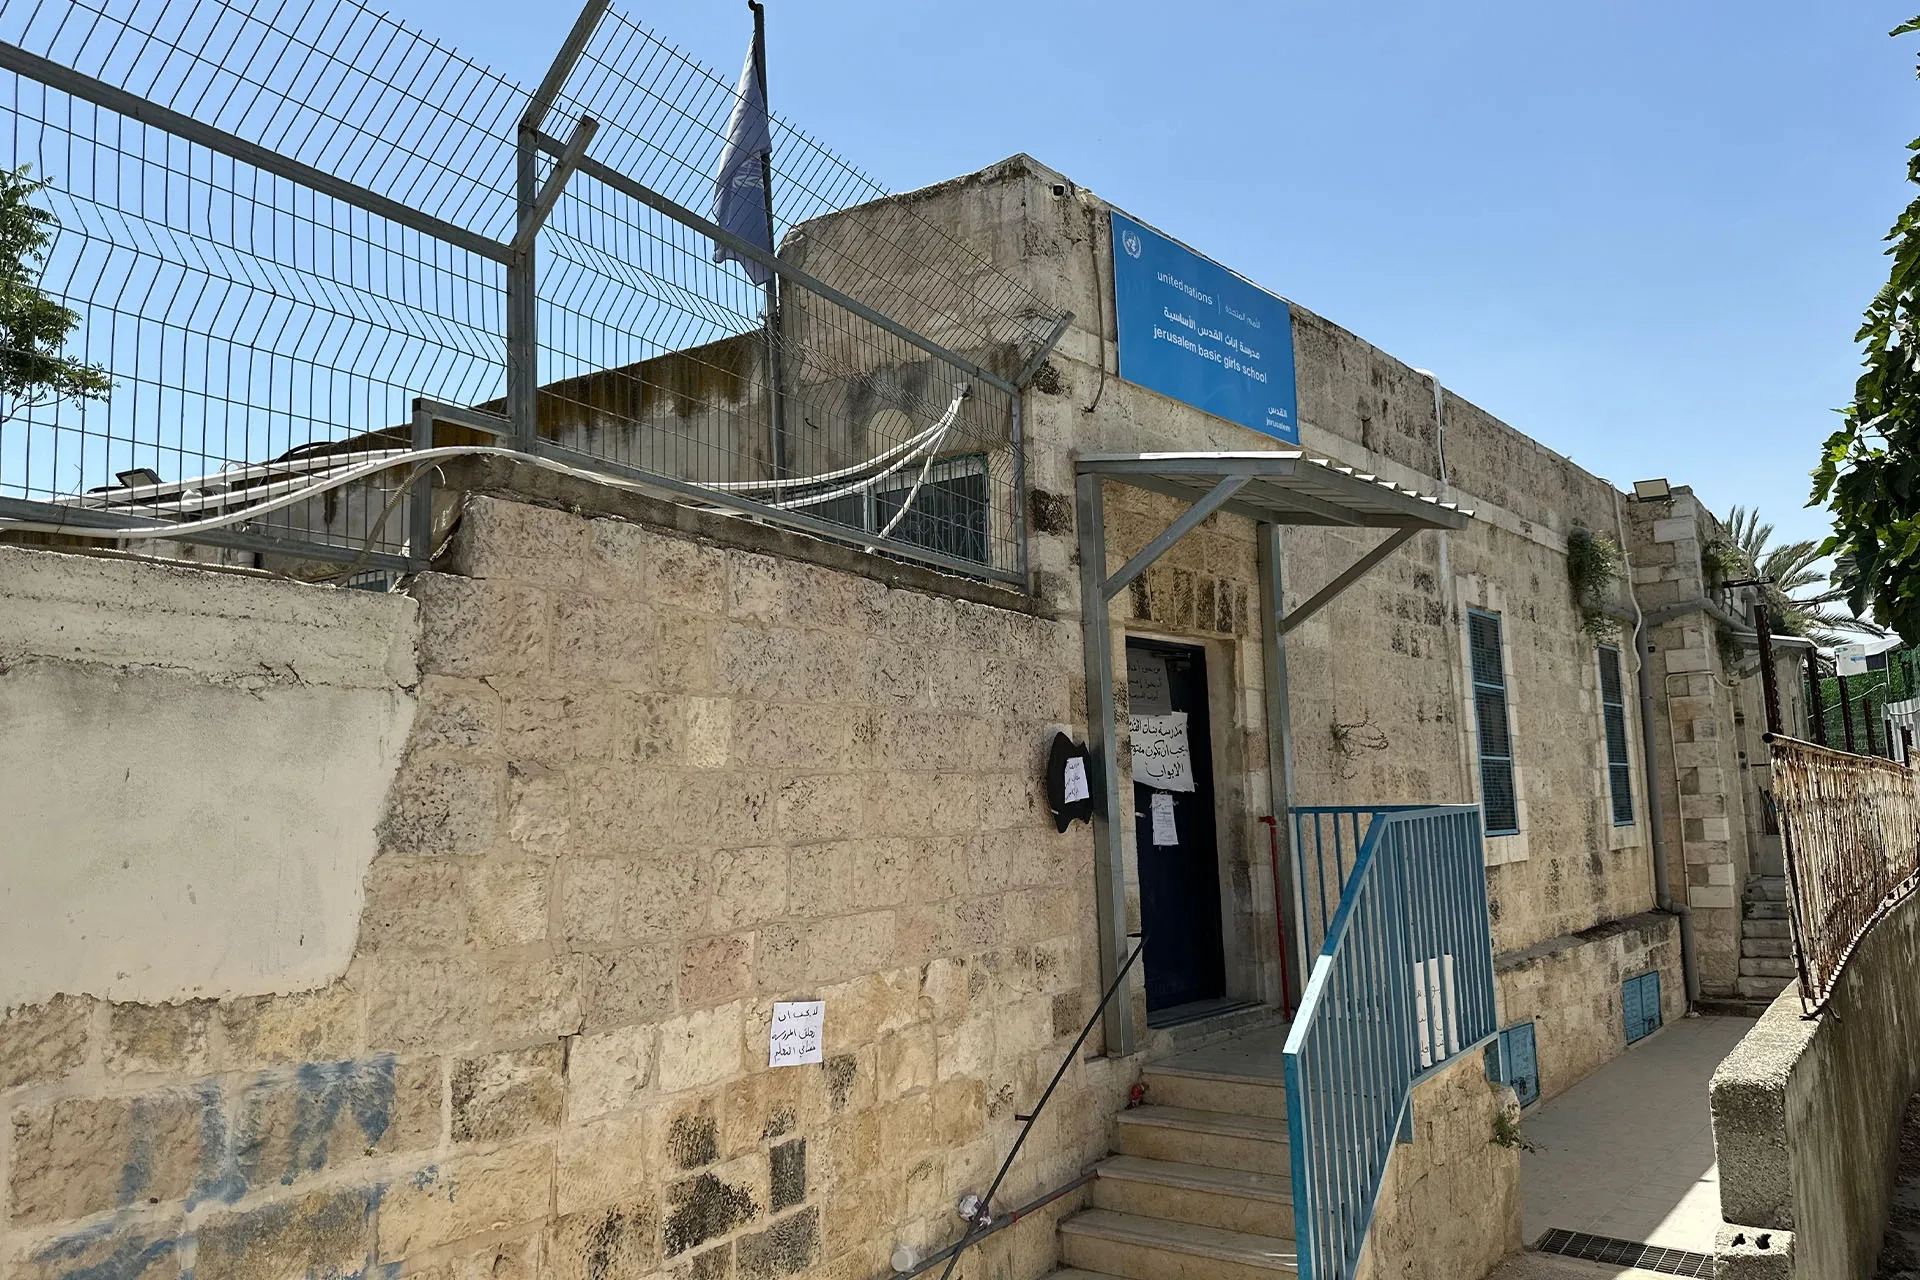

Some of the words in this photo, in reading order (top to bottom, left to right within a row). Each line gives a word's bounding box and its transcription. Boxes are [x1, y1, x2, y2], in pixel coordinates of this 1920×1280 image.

[1157, 271, 1184, 292] united
[1184, 285, 1213, 305] nations
[1163, 306, 1196, 330] الأساسية
[1197, 327, 1223, 343] القدس
[1224, 334, 1238, 352] إناث
[1153, 324, 1197, 354] jerusalem
[1198, 344, 1222, 364] basic
[1224, 354, 1241, 372] girls
[1242, 364, 1267, 384] school
[1239, 342, 1260, 360] مدرسة
[1268, 406, 1288, 419] القدس
[1266, 417, 1291, 433] jerusalem
